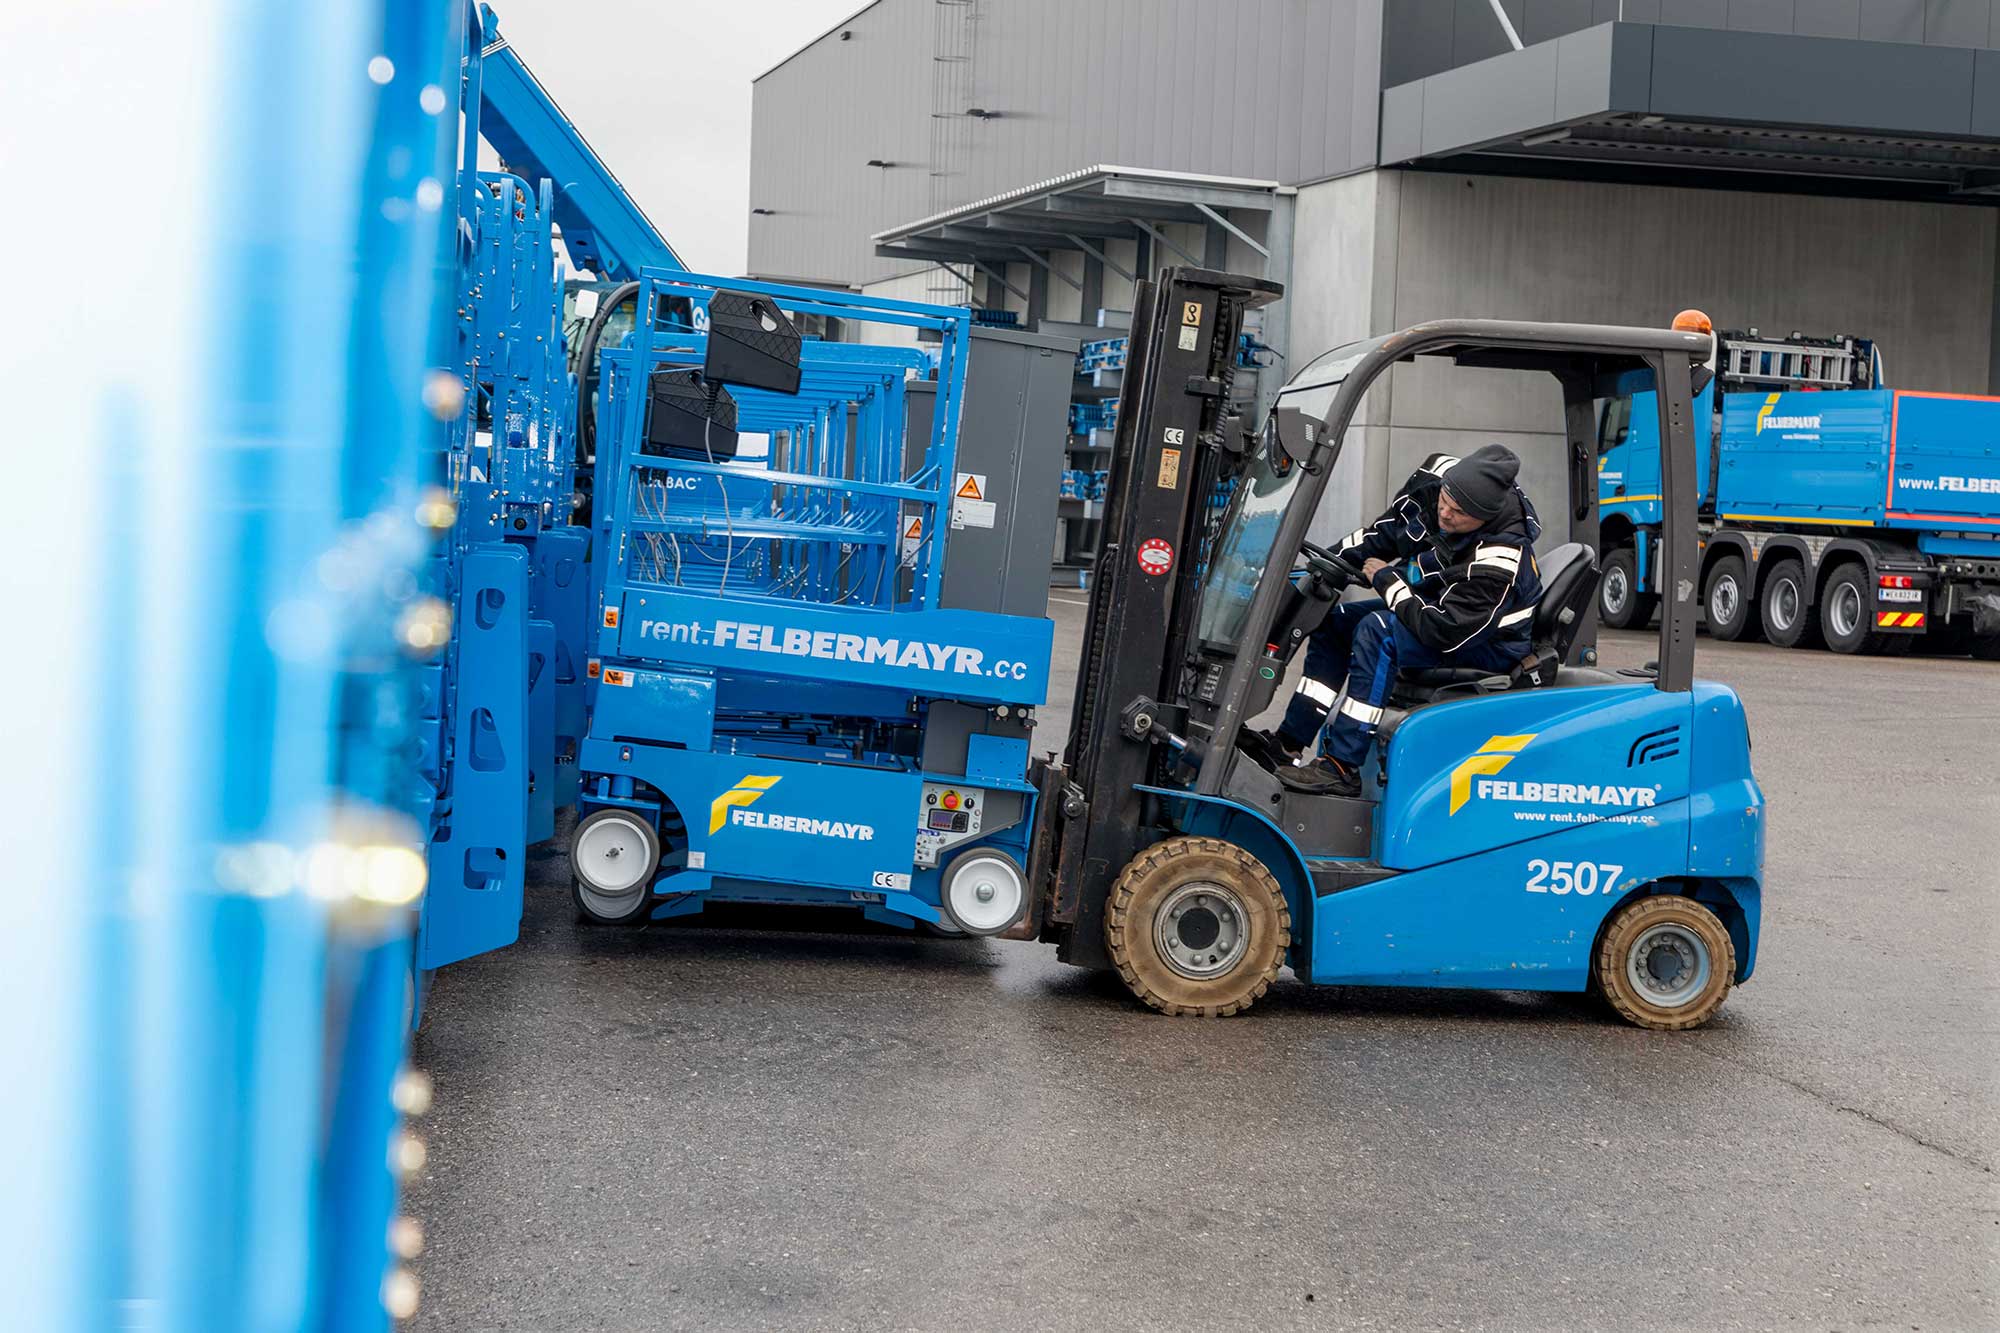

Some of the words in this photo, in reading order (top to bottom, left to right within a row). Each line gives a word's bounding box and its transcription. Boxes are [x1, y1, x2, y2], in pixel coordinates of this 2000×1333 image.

[1165, 429, 1182, 444] CE
[640, 619, 1027, 681] rent.FELBERMAYR.cc
[1478, 780, 1657, 806] FELBERMAYR
[732, 809, 875, 841] FELBERMAYR
[875, 872, 894, 887] CE
[1525, 858, 1624, 896] 2507
